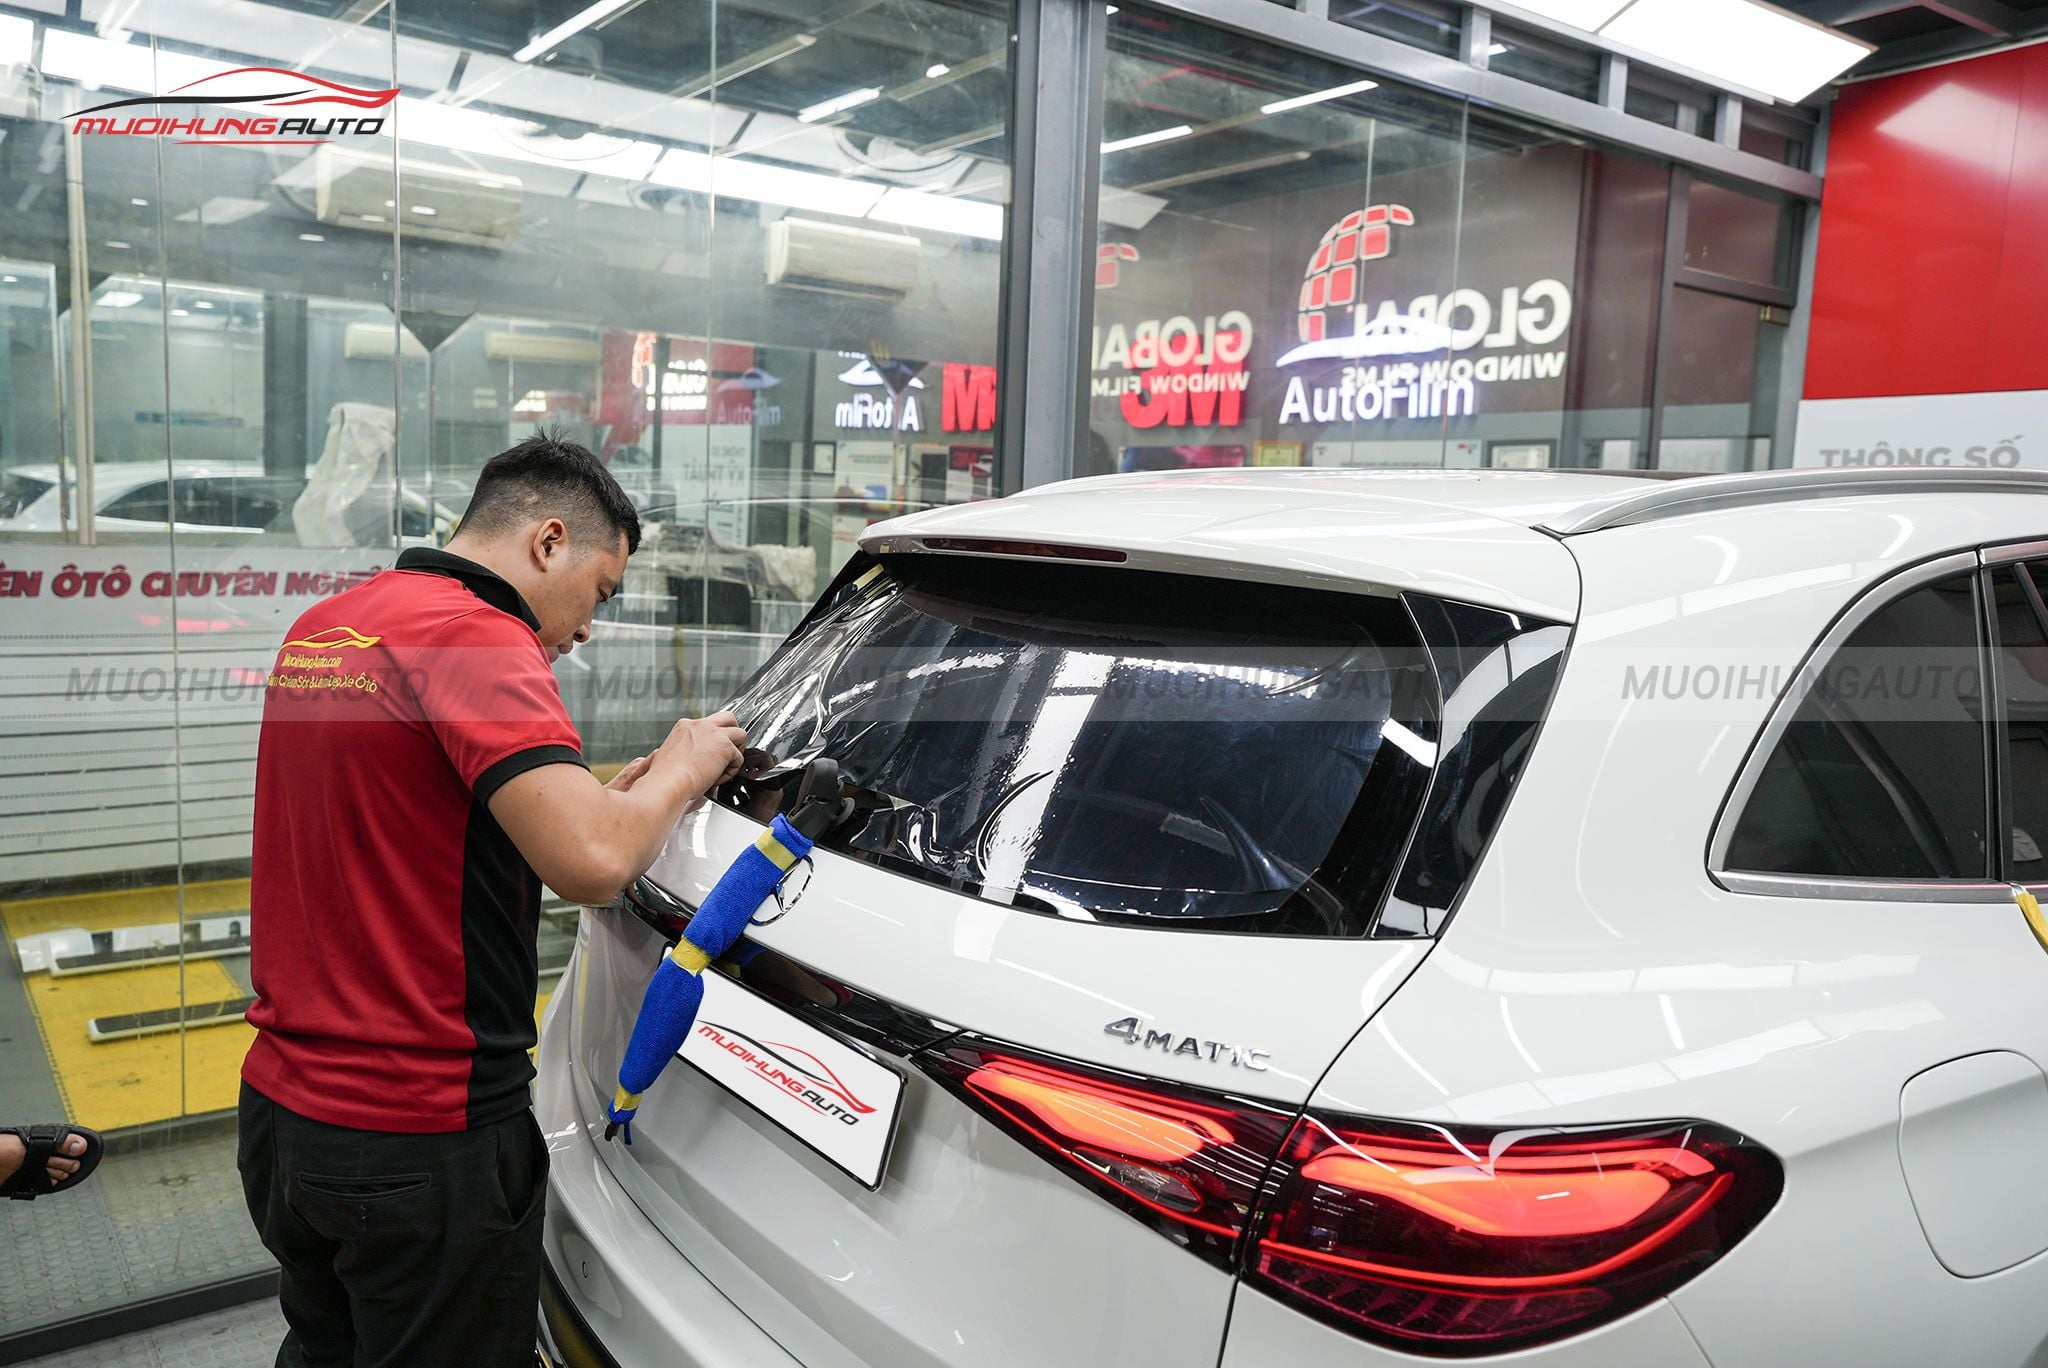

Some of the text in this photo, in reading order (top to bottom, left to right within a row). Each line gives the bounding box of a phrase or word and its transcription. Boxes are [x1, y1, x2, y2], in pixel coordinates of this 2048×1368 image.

[1278, 368, 1474, 425] AutoFilm
[51, 563, 133, 599] ÔTÔ
[141, 564, 279, 599] CHUYÊN
[1103, 1016, 1272, 1072] 4MATIC
[697, 1025, 860, 1126] MUOIHUNGAUTO
